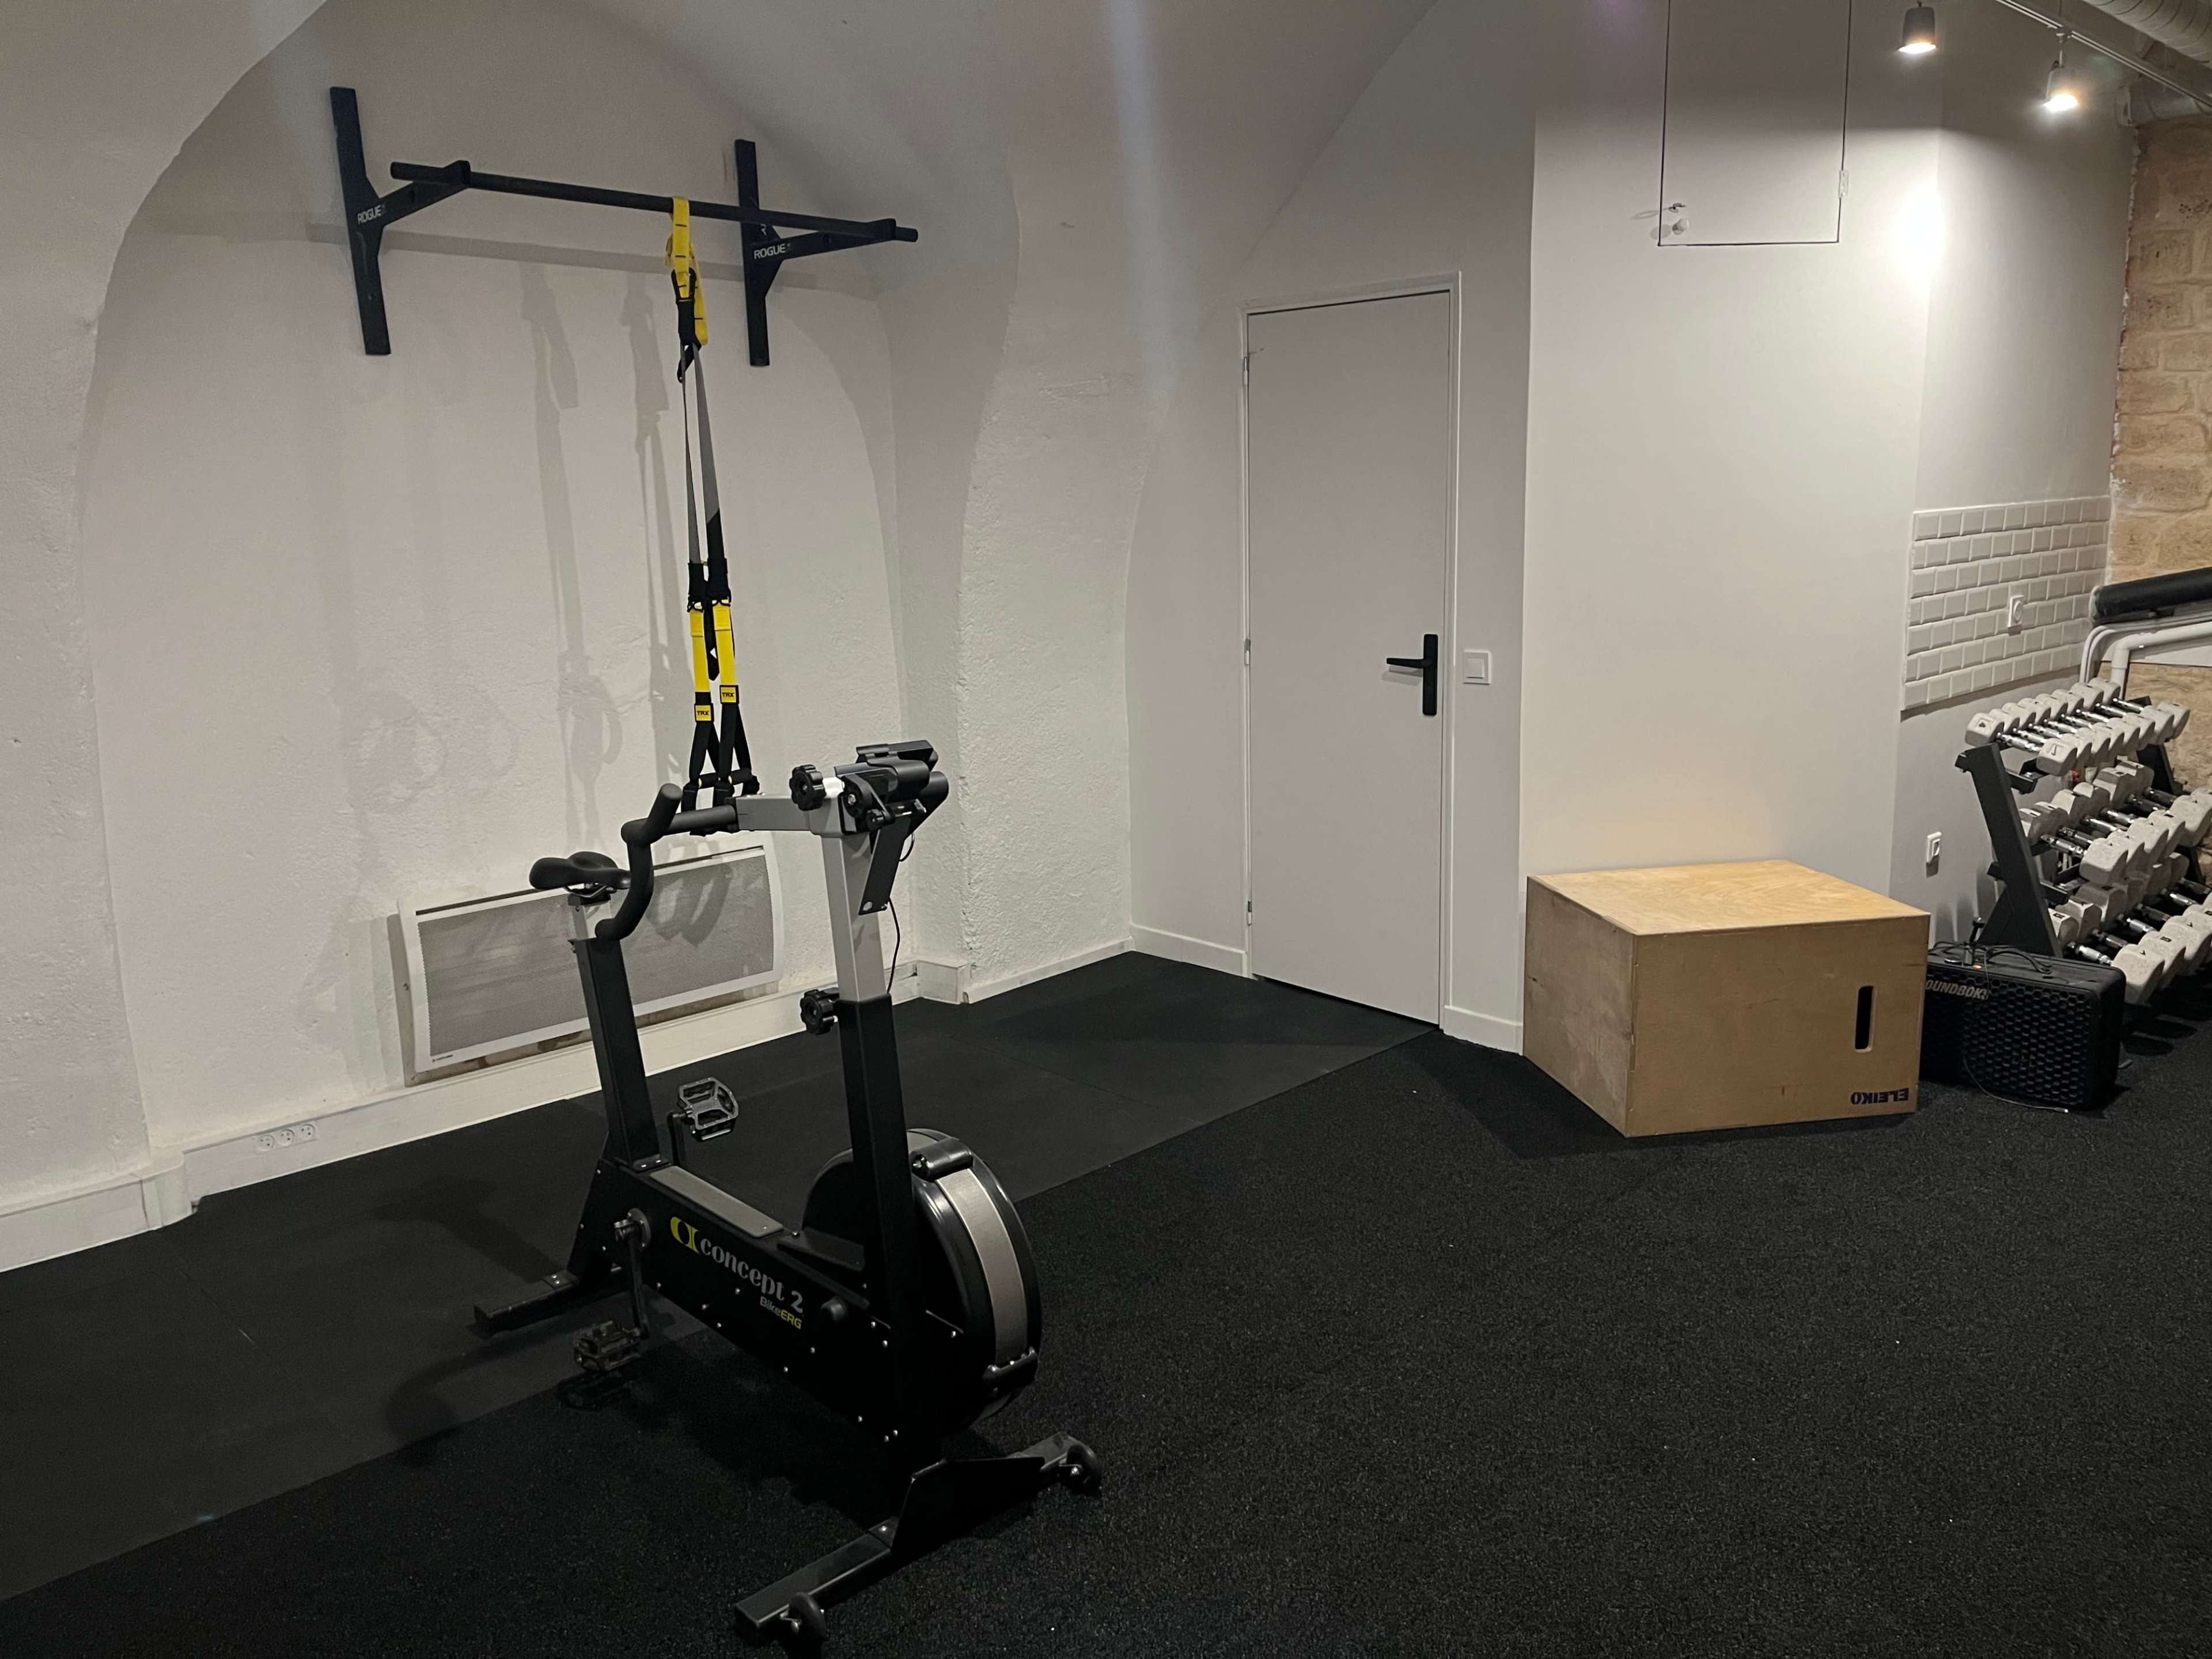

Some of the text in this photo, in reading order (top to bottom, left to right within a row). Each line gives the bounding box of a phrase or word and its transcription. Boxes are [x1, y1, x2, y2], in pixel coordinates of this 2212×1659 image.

[357, 204, 381, 225] ROGUE
[753, 243, 786, 260] ROGUE
[1925, 979, 1991, 1000] OUNDBOKS
[1850, 1087, 1910, 1105] ELEIKO
[700, 1238, 803, 1314] concept 2
[760, 1296, 802, 1330] BikeERG
